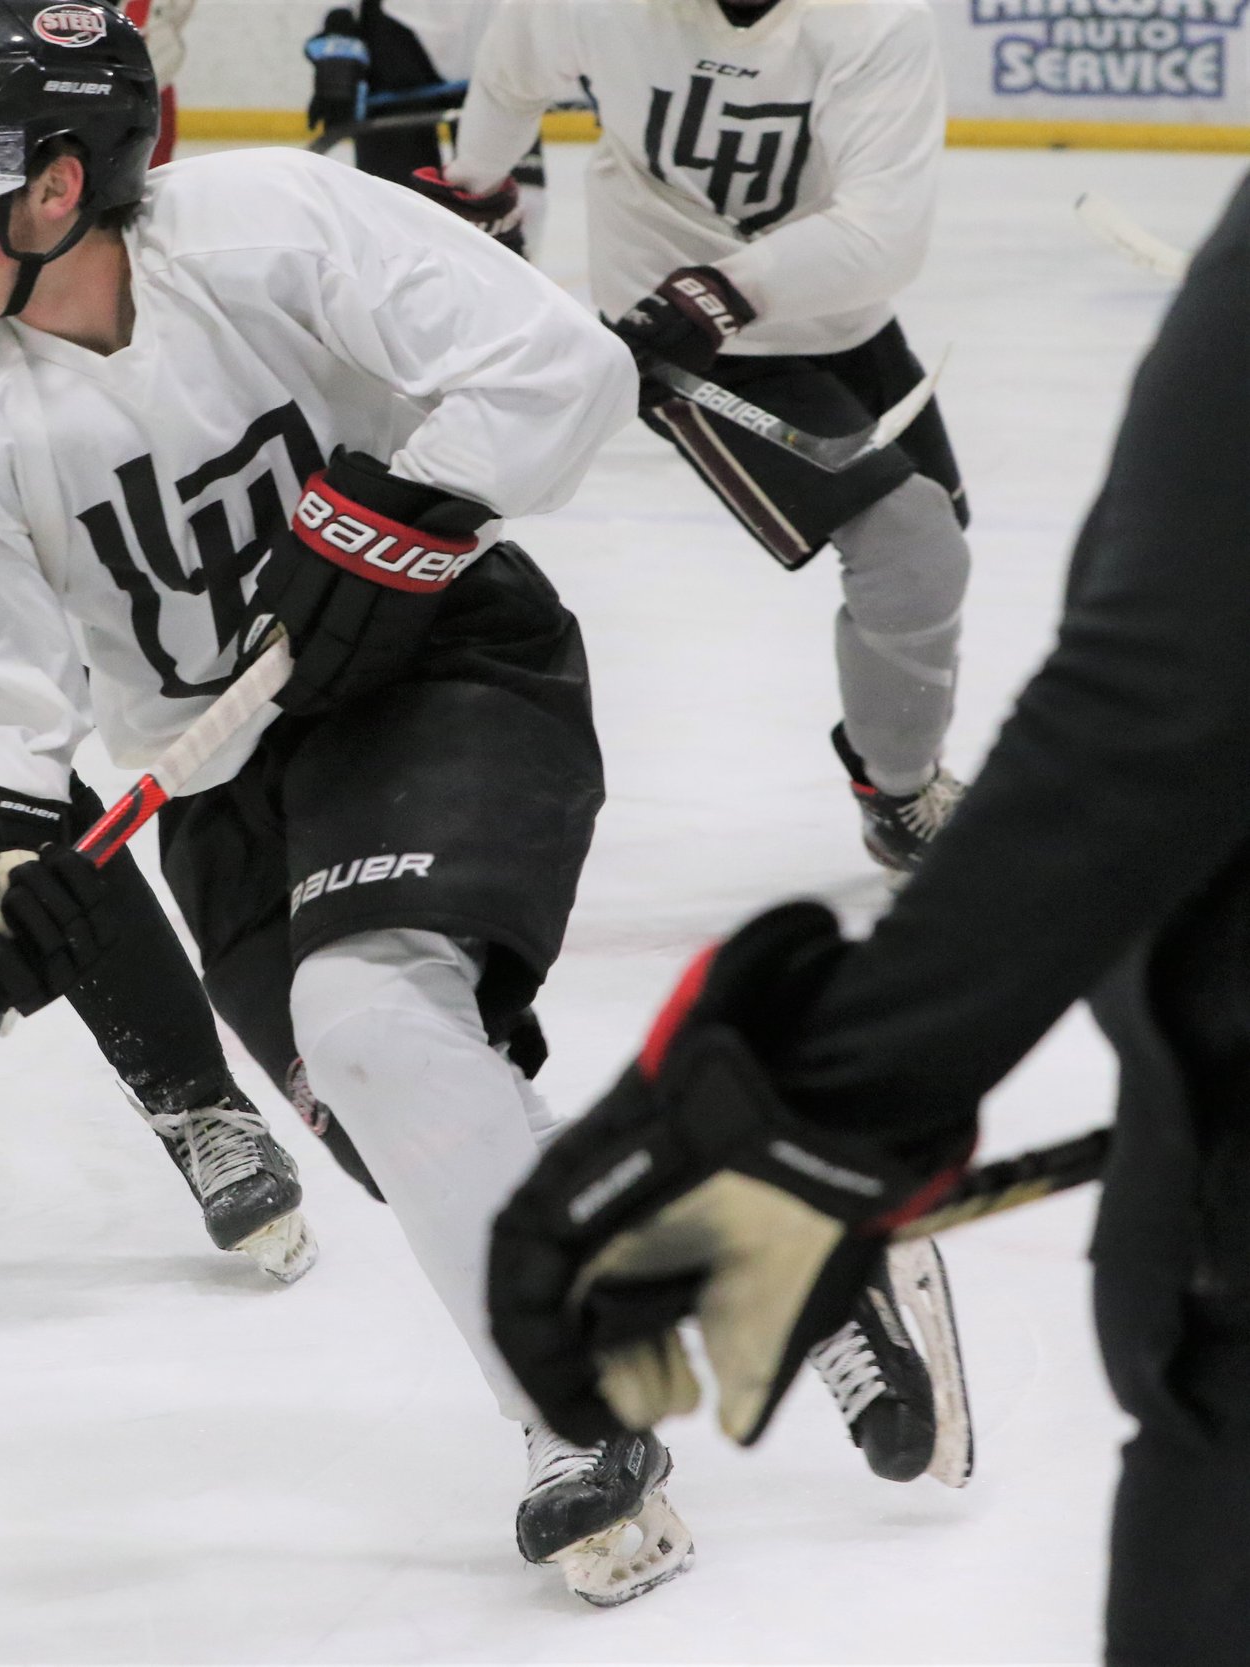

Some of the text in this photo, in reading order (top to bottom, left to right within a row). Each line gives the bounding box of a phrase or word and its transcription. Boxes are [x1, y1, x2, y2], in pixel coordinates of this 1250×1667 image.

[41, 12, 103, 33] STEEL
[1052, 18, 1179, 50] AUTO
[43, 80, 112, 95] BAUER
[695, 59, 760, 79] CCM
[998, 41, 1220, 94] SERVICE
[671, 276, 740, 336] BAU
[692, 380, 782, 438] BAUER
[297, 491, 470, 582] BAUER
[0, 800, 61, 820] BAUER
[290, 852, 435, 920] BAUER
